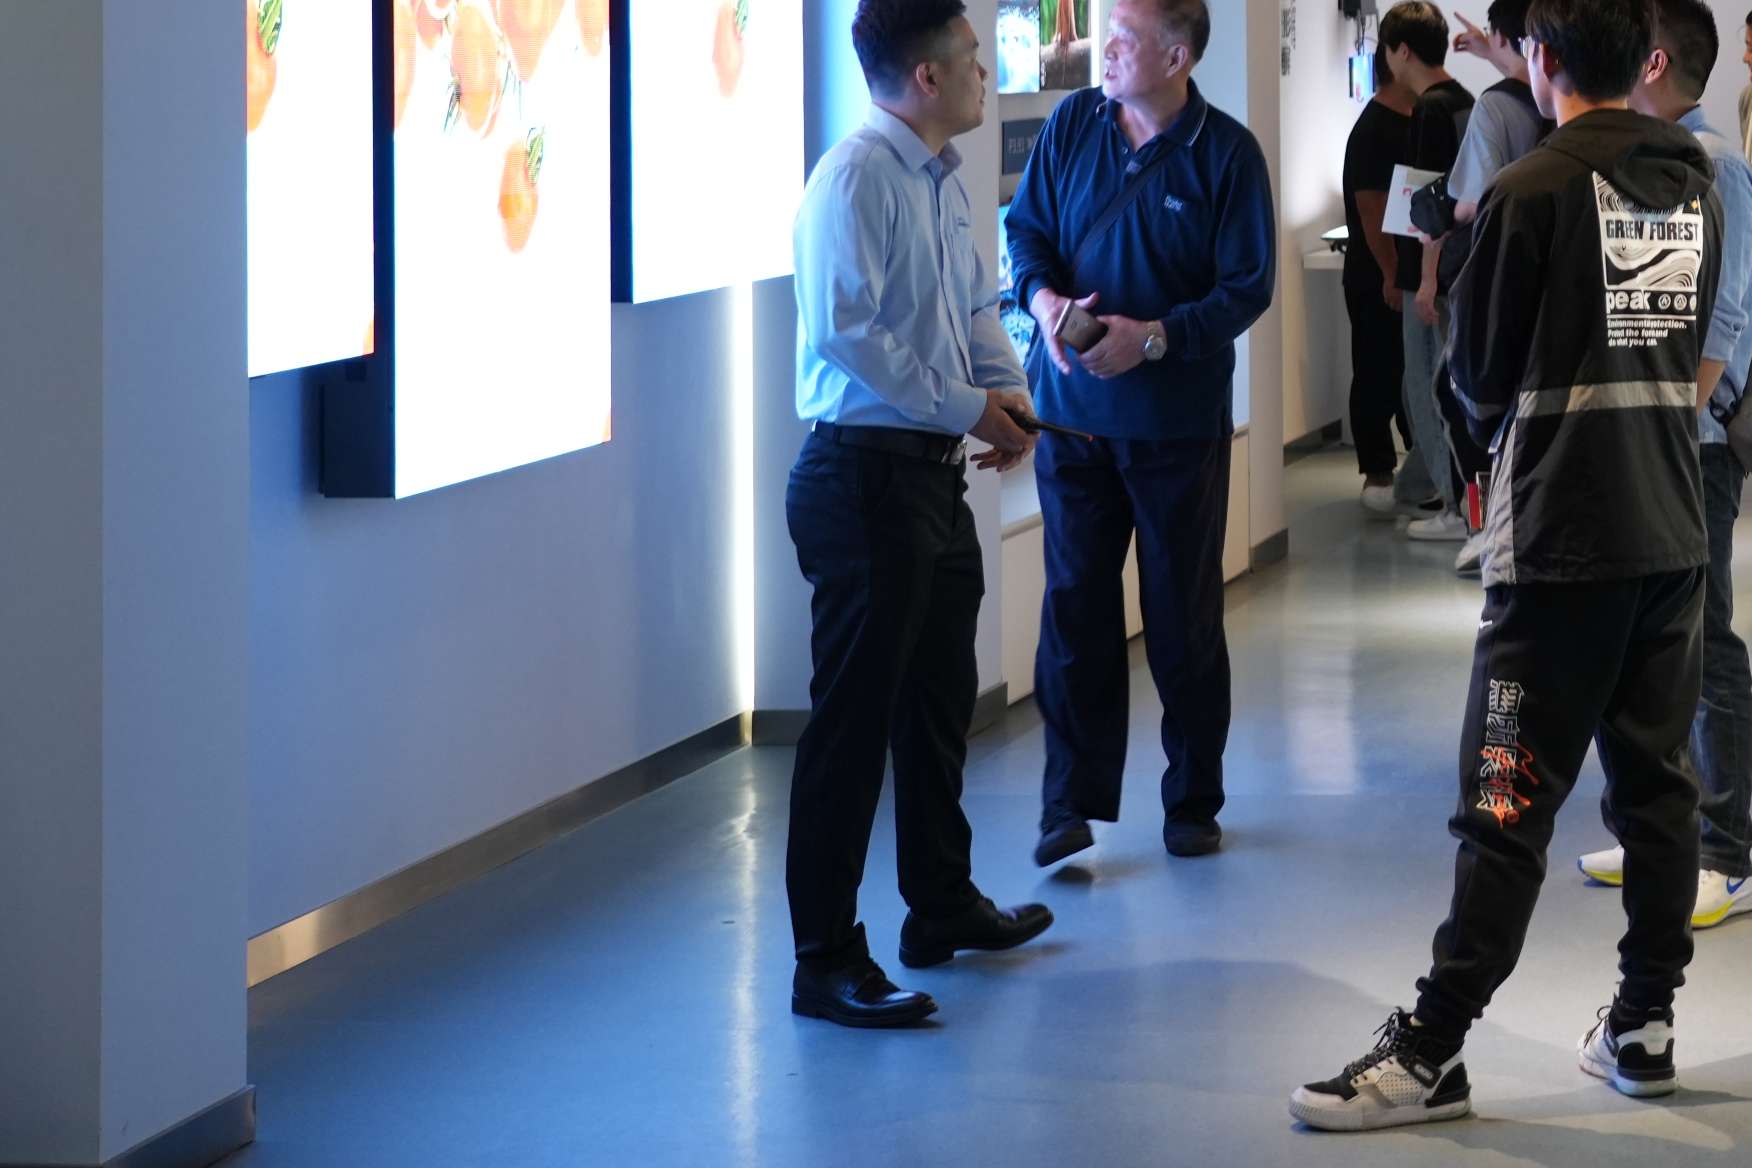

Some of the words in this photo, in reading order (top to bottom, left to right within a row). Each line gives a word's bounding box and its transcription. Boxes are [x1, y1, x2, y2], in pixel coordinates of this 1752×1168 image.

[1605, 219, 1645, 240] GREEN
[1649, 221, 1699, 241] FOREST
[1605, 289, 1652, 314] peak
